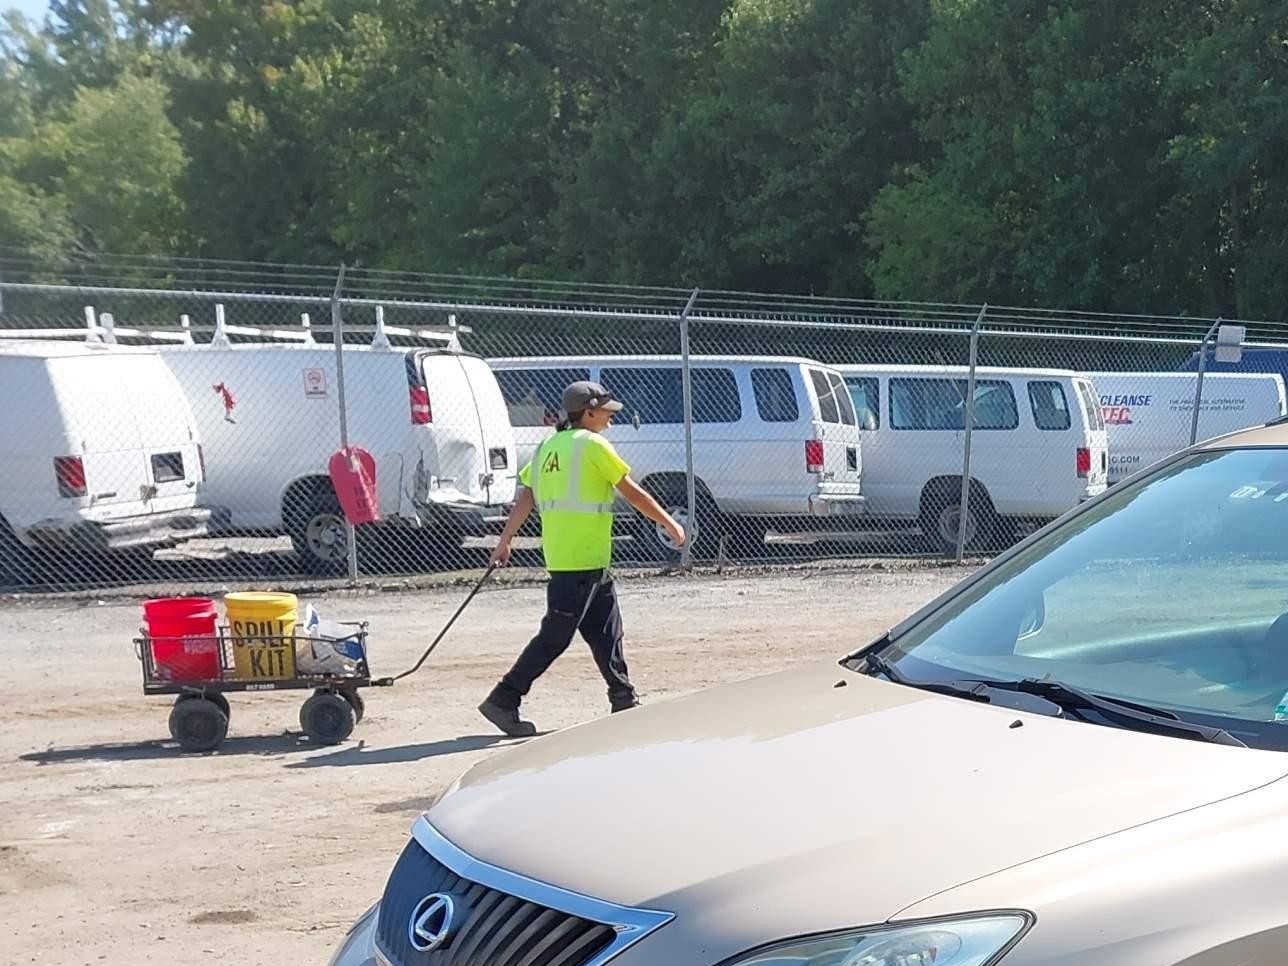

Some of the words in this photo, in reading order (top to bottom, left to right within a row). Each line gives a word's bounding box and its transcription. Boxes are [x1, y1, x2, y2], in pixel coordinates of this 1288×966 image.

[1099, 394, 1152, 406] CLEANSE
[233, 620, 289, 649] SPILL
[251, 649, 286, 677] KIT
